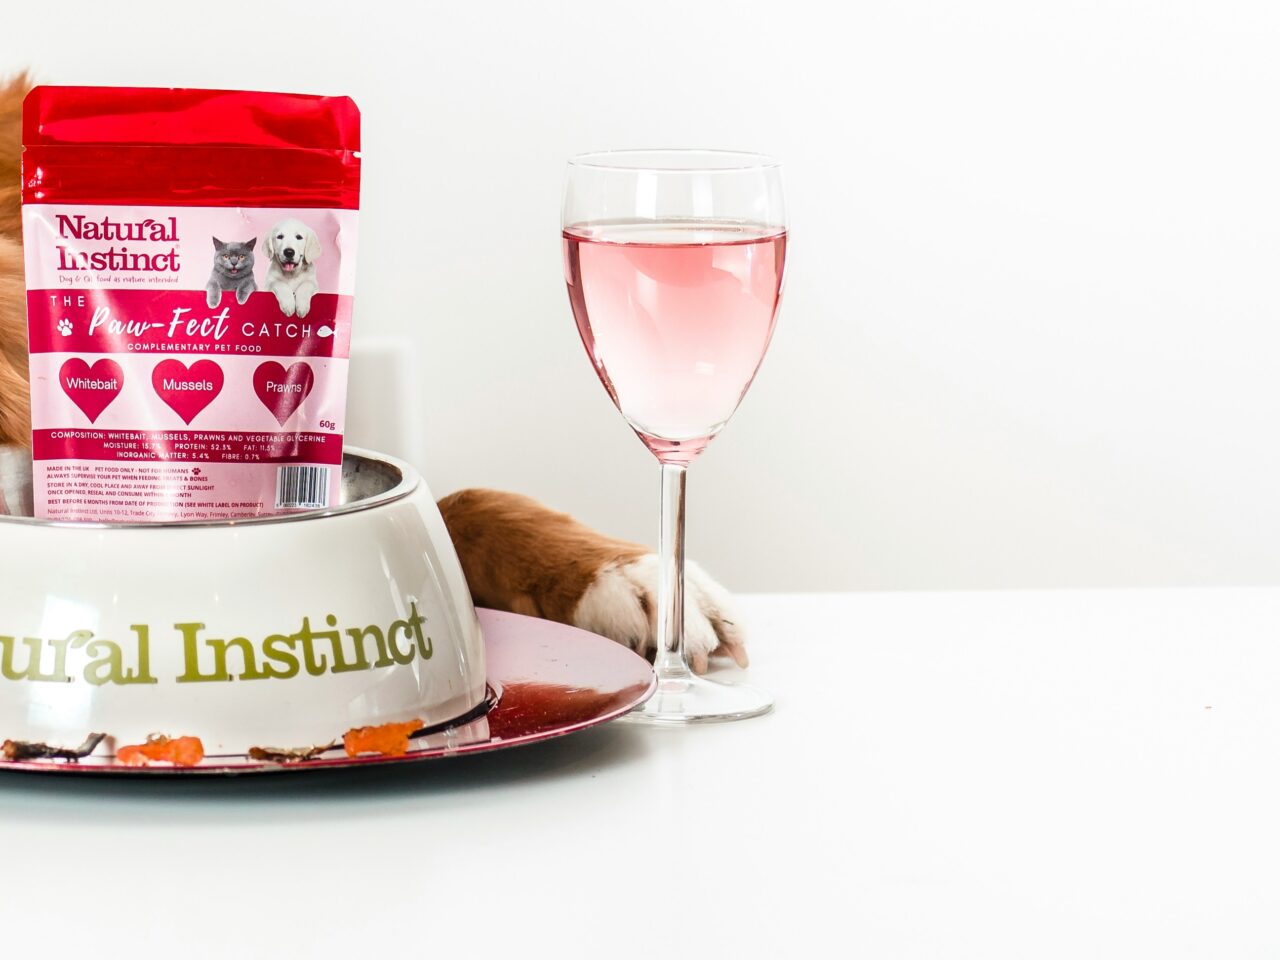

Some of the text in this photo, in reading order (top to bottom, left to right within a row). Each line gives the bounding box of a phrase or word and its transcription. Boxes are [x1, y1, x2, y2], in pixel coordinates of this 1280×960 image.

[55, 214, 180, 242] Natural
[55, 245, 181, 272] Instinct
[59, 274, 73, 286] Dog
[96, 274, 112, 283] food
[123, 275, 146, 283] nature
[148, 274, 179, 283] intended
[50, 295, 85, 307] THE
[88, 306, 312, 340] Paw-Fect CATCH
[127, 343, 210, 352] COMPLEMENTARY
[214, 344, 231, 352] PET
[66, 377, 118, 390] Whitebait
[163, 378, 213, 391] Mussels
[266, 381, 302, 393] Prawns
[319, 420, 336, 431] 60g
[50, 431, 106, 440] COMPOSITION:
[108, 432, 148, 441] WHITEBAIT,
[193, 433, 226, 441] PRAWNS
[228, 434, 243, 442] AND
[245, 435, 285, 443] VEGETABLE
[286, 435, 326, 443] GLYCERINE
[174, 443, 208, 451] PROTEIN:
[116, 451, 156, 459] INORGANIC
[173, 599, 435, 683] Instinct
